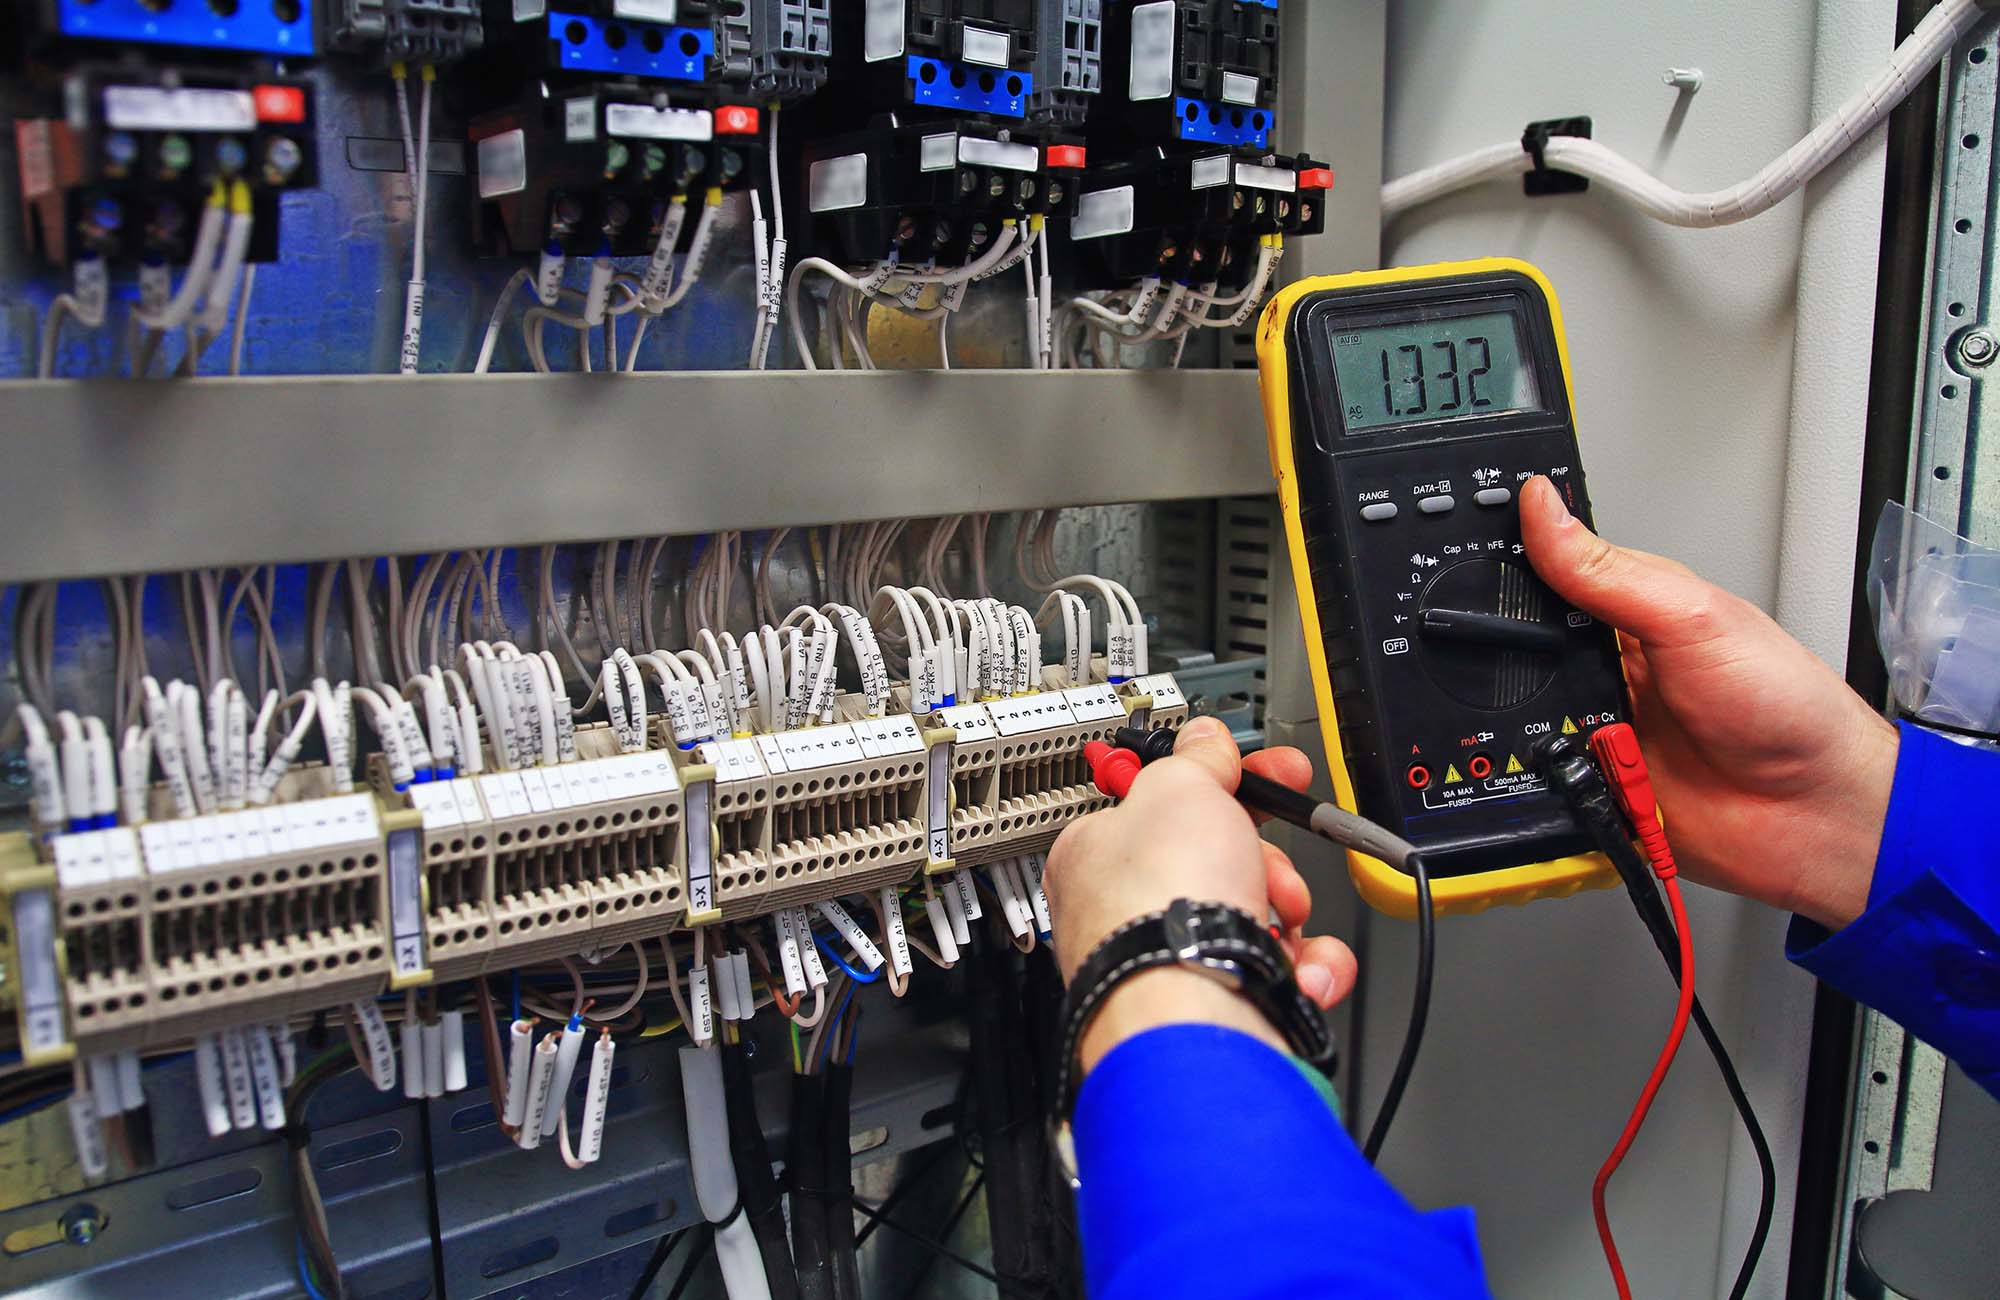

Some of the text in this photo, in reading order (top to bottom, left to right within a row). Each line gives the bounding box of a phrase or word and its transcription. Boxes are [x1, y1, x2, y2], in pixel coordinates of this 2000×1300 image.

[1339, 335, 1359, 345] AUTO
[1381, 337, 1491, 416] 1.332
[1349, 405, 1362, 414] AC
[1516, 471, 1534, 481] NPN
[1551, 466, 1568, 476] PNP
[1358, 489, 1390, 502] RANGE
[1443, 545, 1461, 555] Cap
[1466, 542, 1479, 551] Hz
[1487, 540, 1504, 550] hFE
[1385, 641, 1406, 652] OFF
[1019, 648, 1027, 687] 4-F2:2
[736, 667, 749, 701] 3-X:1
[1166, 687, 1176, 695] C
[966, 720, 975, 728] B
[977, 718, 987, 727] C
[1097, 698, 1106, 706] 9
[1110, 693, 1119, 705] 10
[1524, 721, 1551, 735] COM
[728, 758, 739, 766] B
[744, 755, 755, 763] C
[785, 746, 795, 754] 2
[801, 744, 811, 752] 3
[832, 740, 842, 748] 5
[846, 738, 856, 746] 6
[862, 735, 873, 743] 7
[877, 733, 888, 741] 8
[892, 731, 902, 739] 9
[905, 726, 916, 739] 10
[1461, 736, 1478, 746] mA
[1412, 744, 1420, 754] A
[1494, 773, 1536, 786] 500mA MAX
[1443, 787, 1474, 798] 10A MAX
[1448, 798, 1473, 808] FUSED
[934, 838, 944, 858] 4-X
[696, 885, 707, 908] 3-X
